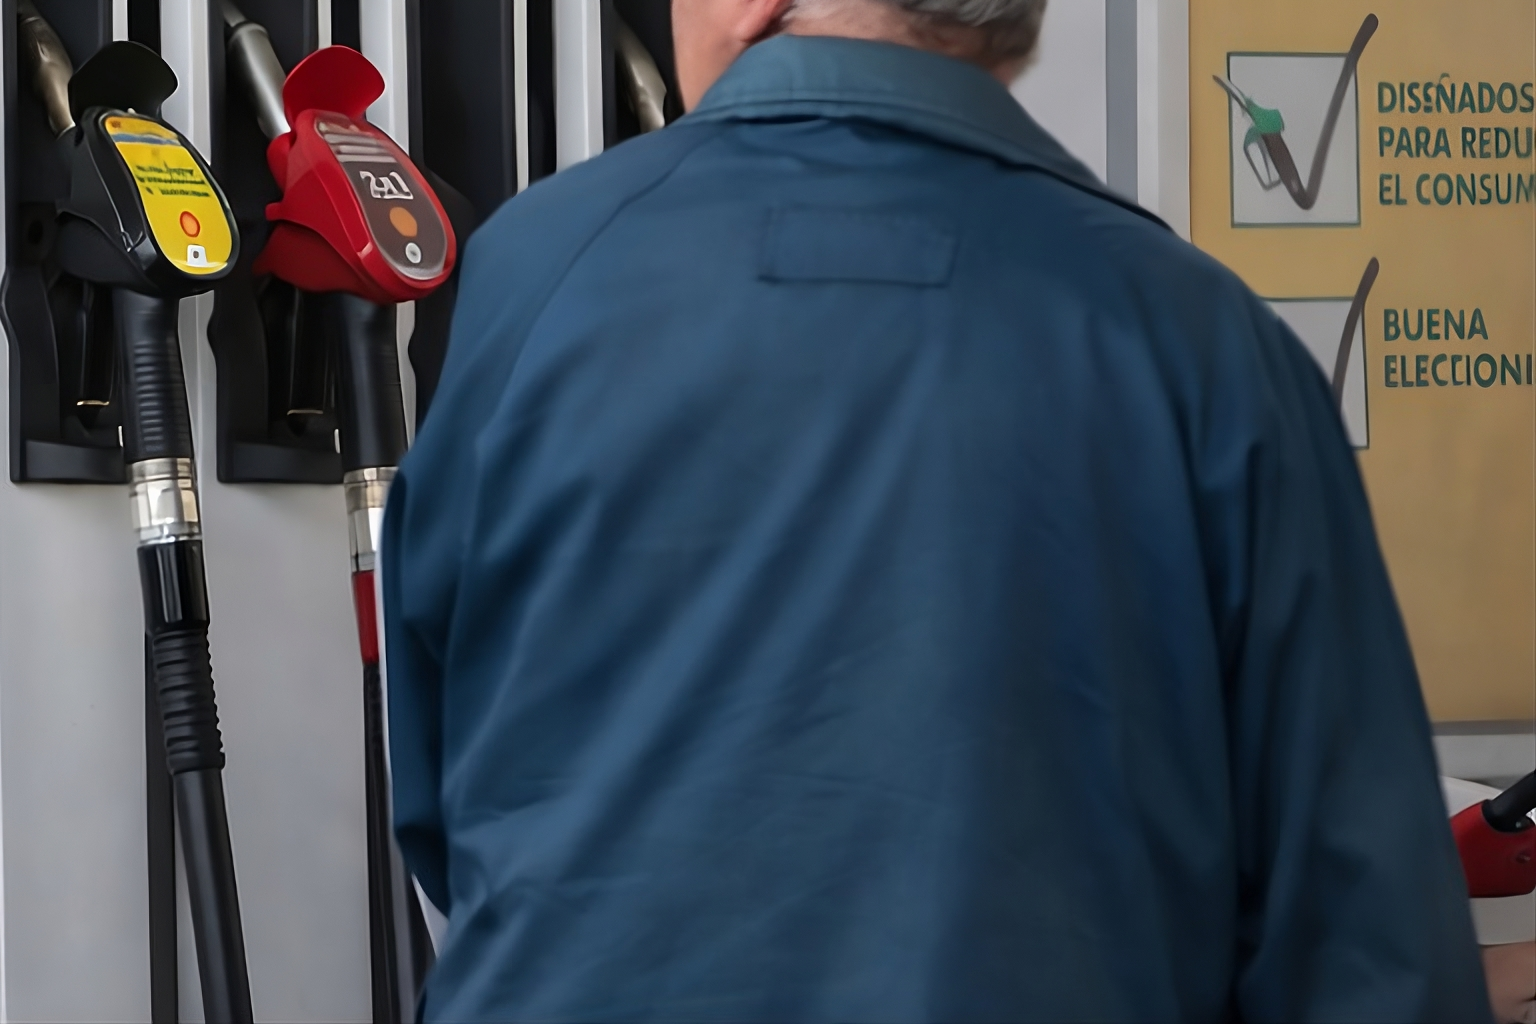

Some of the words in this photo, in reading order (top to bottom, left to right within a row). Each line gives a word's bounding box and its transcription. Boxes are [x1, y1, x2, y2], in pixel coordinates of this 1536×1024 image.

[1378, 126, 1452, 159] PARA
[1378, 173, 1408, 206] EL
[1383, 307, 1489, 342] BUENA
